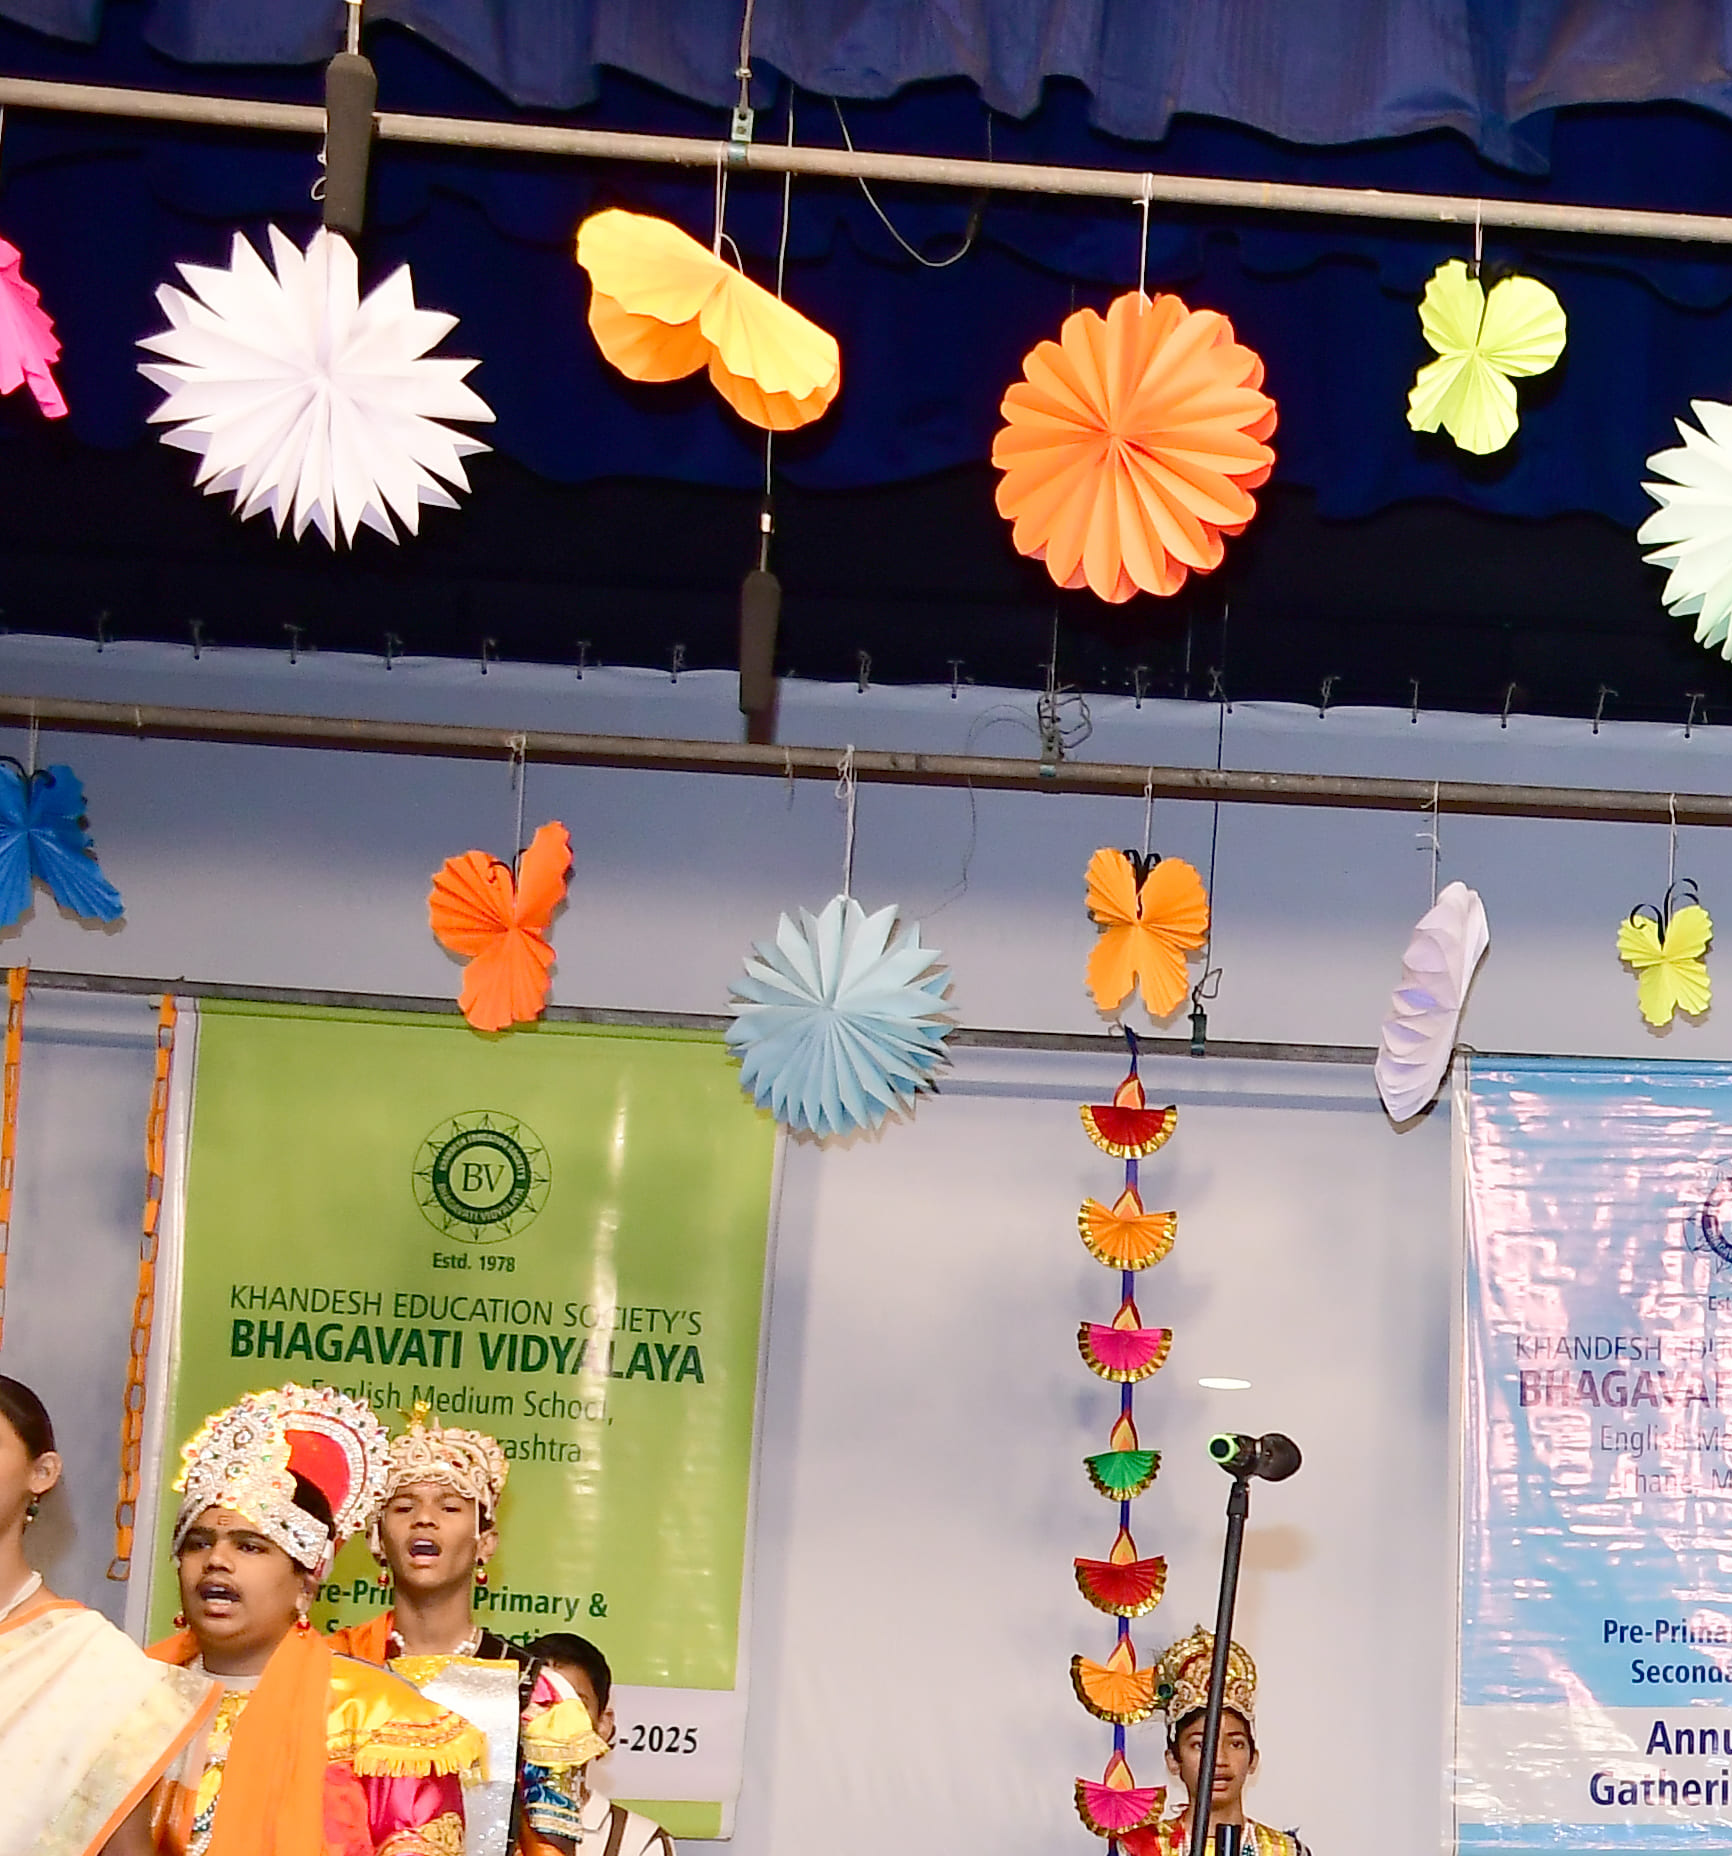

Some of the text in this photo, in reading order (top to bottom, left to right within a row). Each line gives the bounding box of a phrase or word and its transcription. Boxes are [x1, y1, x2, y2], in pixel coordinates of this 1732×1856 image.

[462, 1162, 505, 1193] BV
[432, 1252, 516, 1273] Estd. 1978
[231, 1284, 383, 1316] KHANDESH
[393, 1293, 553, 1326] EDUCATION
[230, 1318, 705, 1384] BHAGAVATI VIDYALAYA
[1516, 1336, 1662, 1361] KHANDESH
[311, 1379, 400, 1409] lish
[412, 1384, 514, 1416] Medium
[1601, 1424, 1687, 1459] English
[473, 1586, 580, 1622] Primary
[588, 1592, 609, 1618] &
